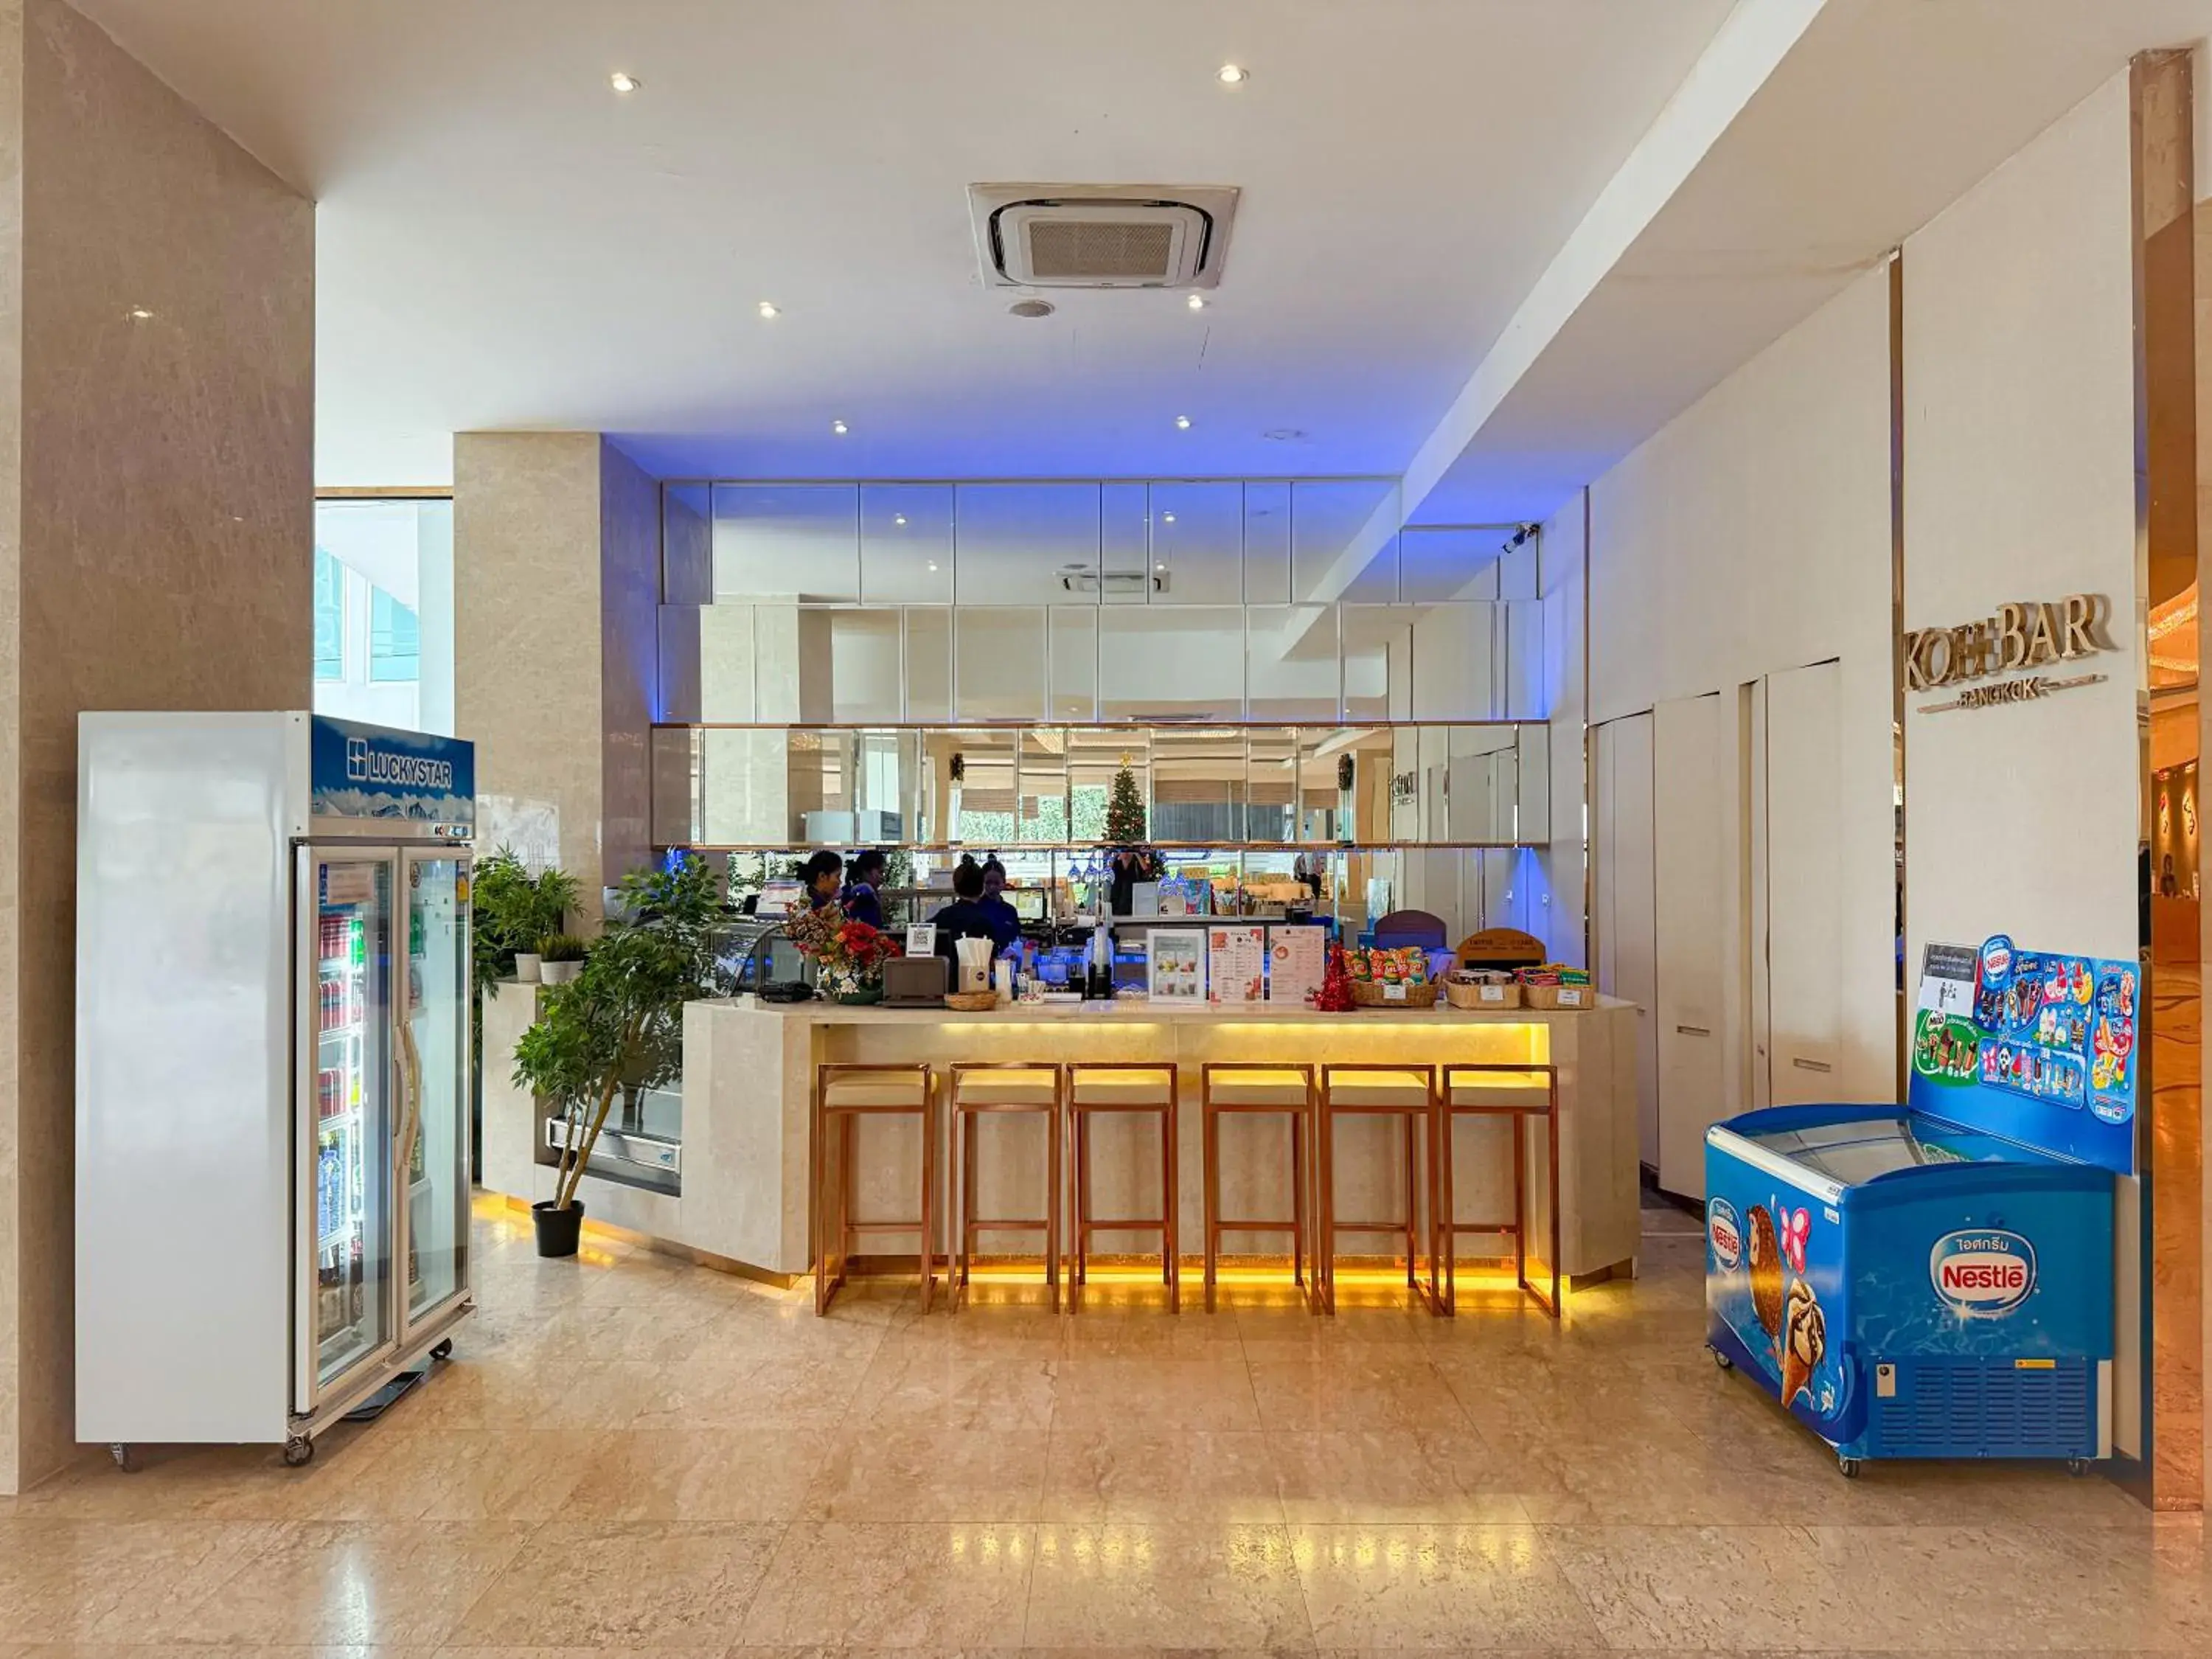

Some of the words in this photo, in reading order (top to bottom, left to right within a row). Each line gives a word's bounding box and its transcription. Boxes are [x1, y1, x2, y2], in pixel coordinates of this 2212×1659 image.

[1958, 676, 2039, 710] BANGKOK
[368, 751, 452, 789] LUCKYSTAR
[1712, 1223, 1738, 1255] Nestlé
[1955, 1236, 2010, 1252] ไอศกรีม
[1943, 1264, 2024, 1289] Nestlé
